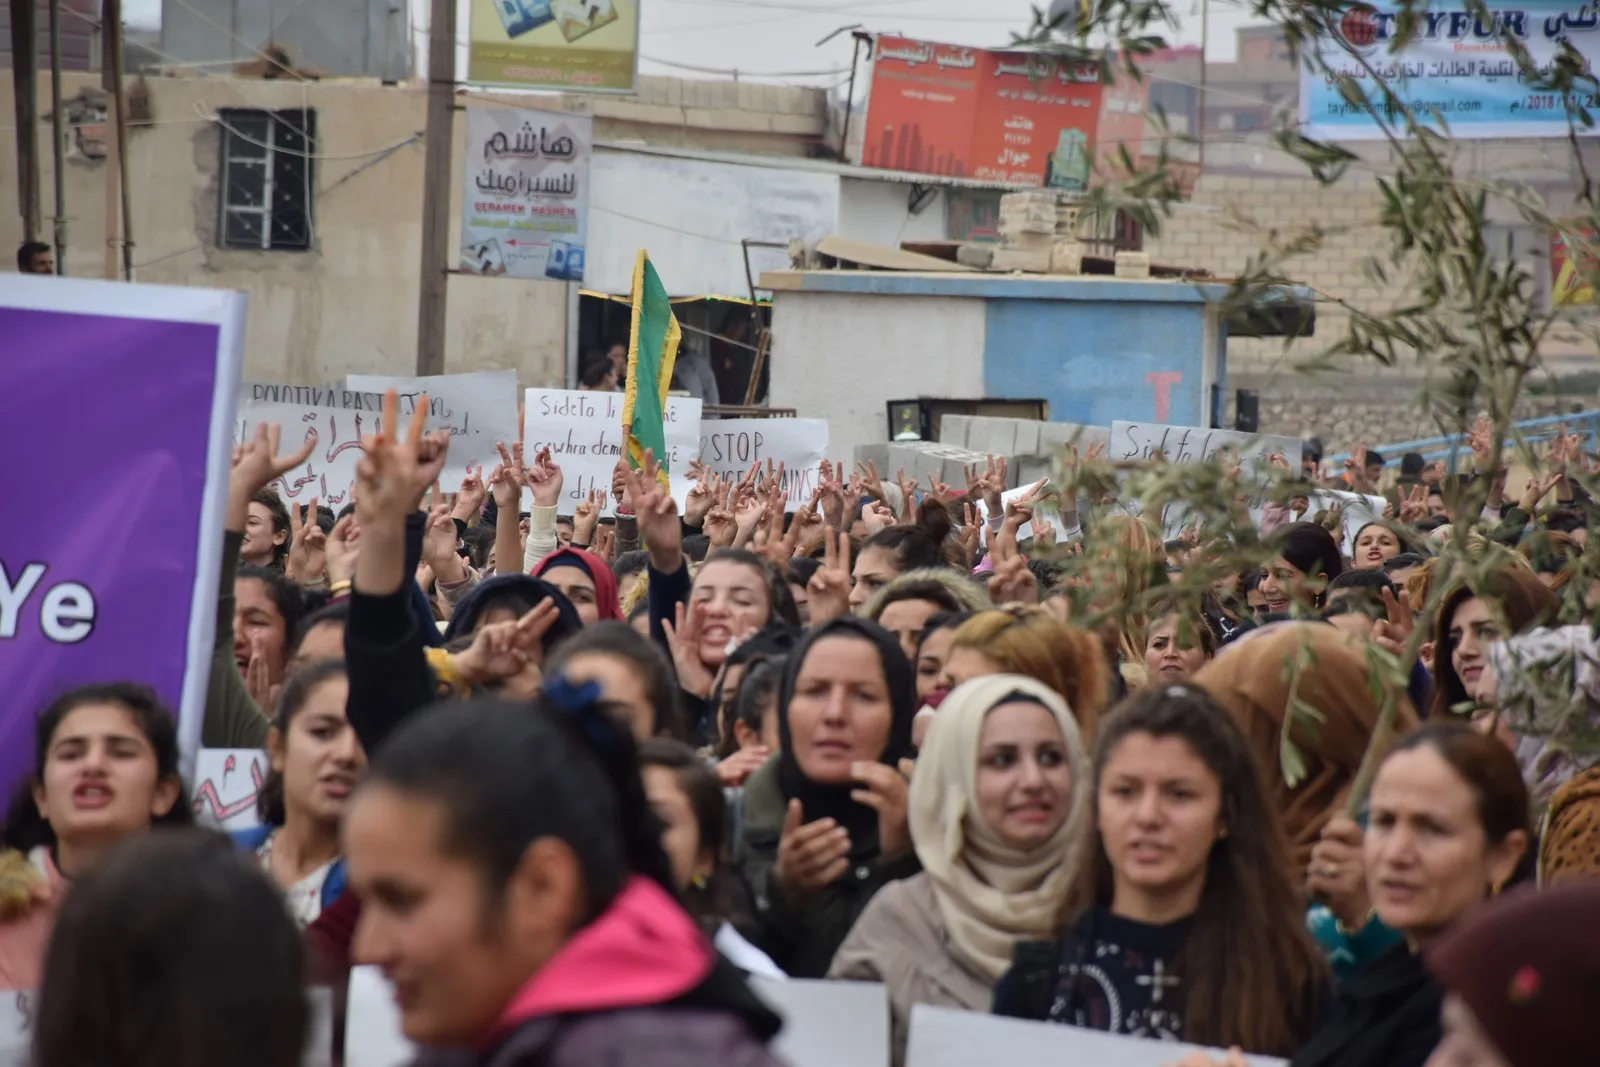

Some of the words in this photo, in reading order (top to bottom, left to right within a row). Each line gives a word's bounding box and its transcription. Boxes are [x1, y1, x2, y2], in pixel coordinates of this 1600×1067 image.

[1373, 9, 1527, 40] TYFUR
[936, 45, 976, 70] مكتب
[483, 121, 574, 161] هاشم
[476, 168, 575, 202] للسيراميك
[474, 202, 525, 214] CERAMEK
[532, 206, 577, 220] HASHEM
[711, 431, 764, 462] STOP
